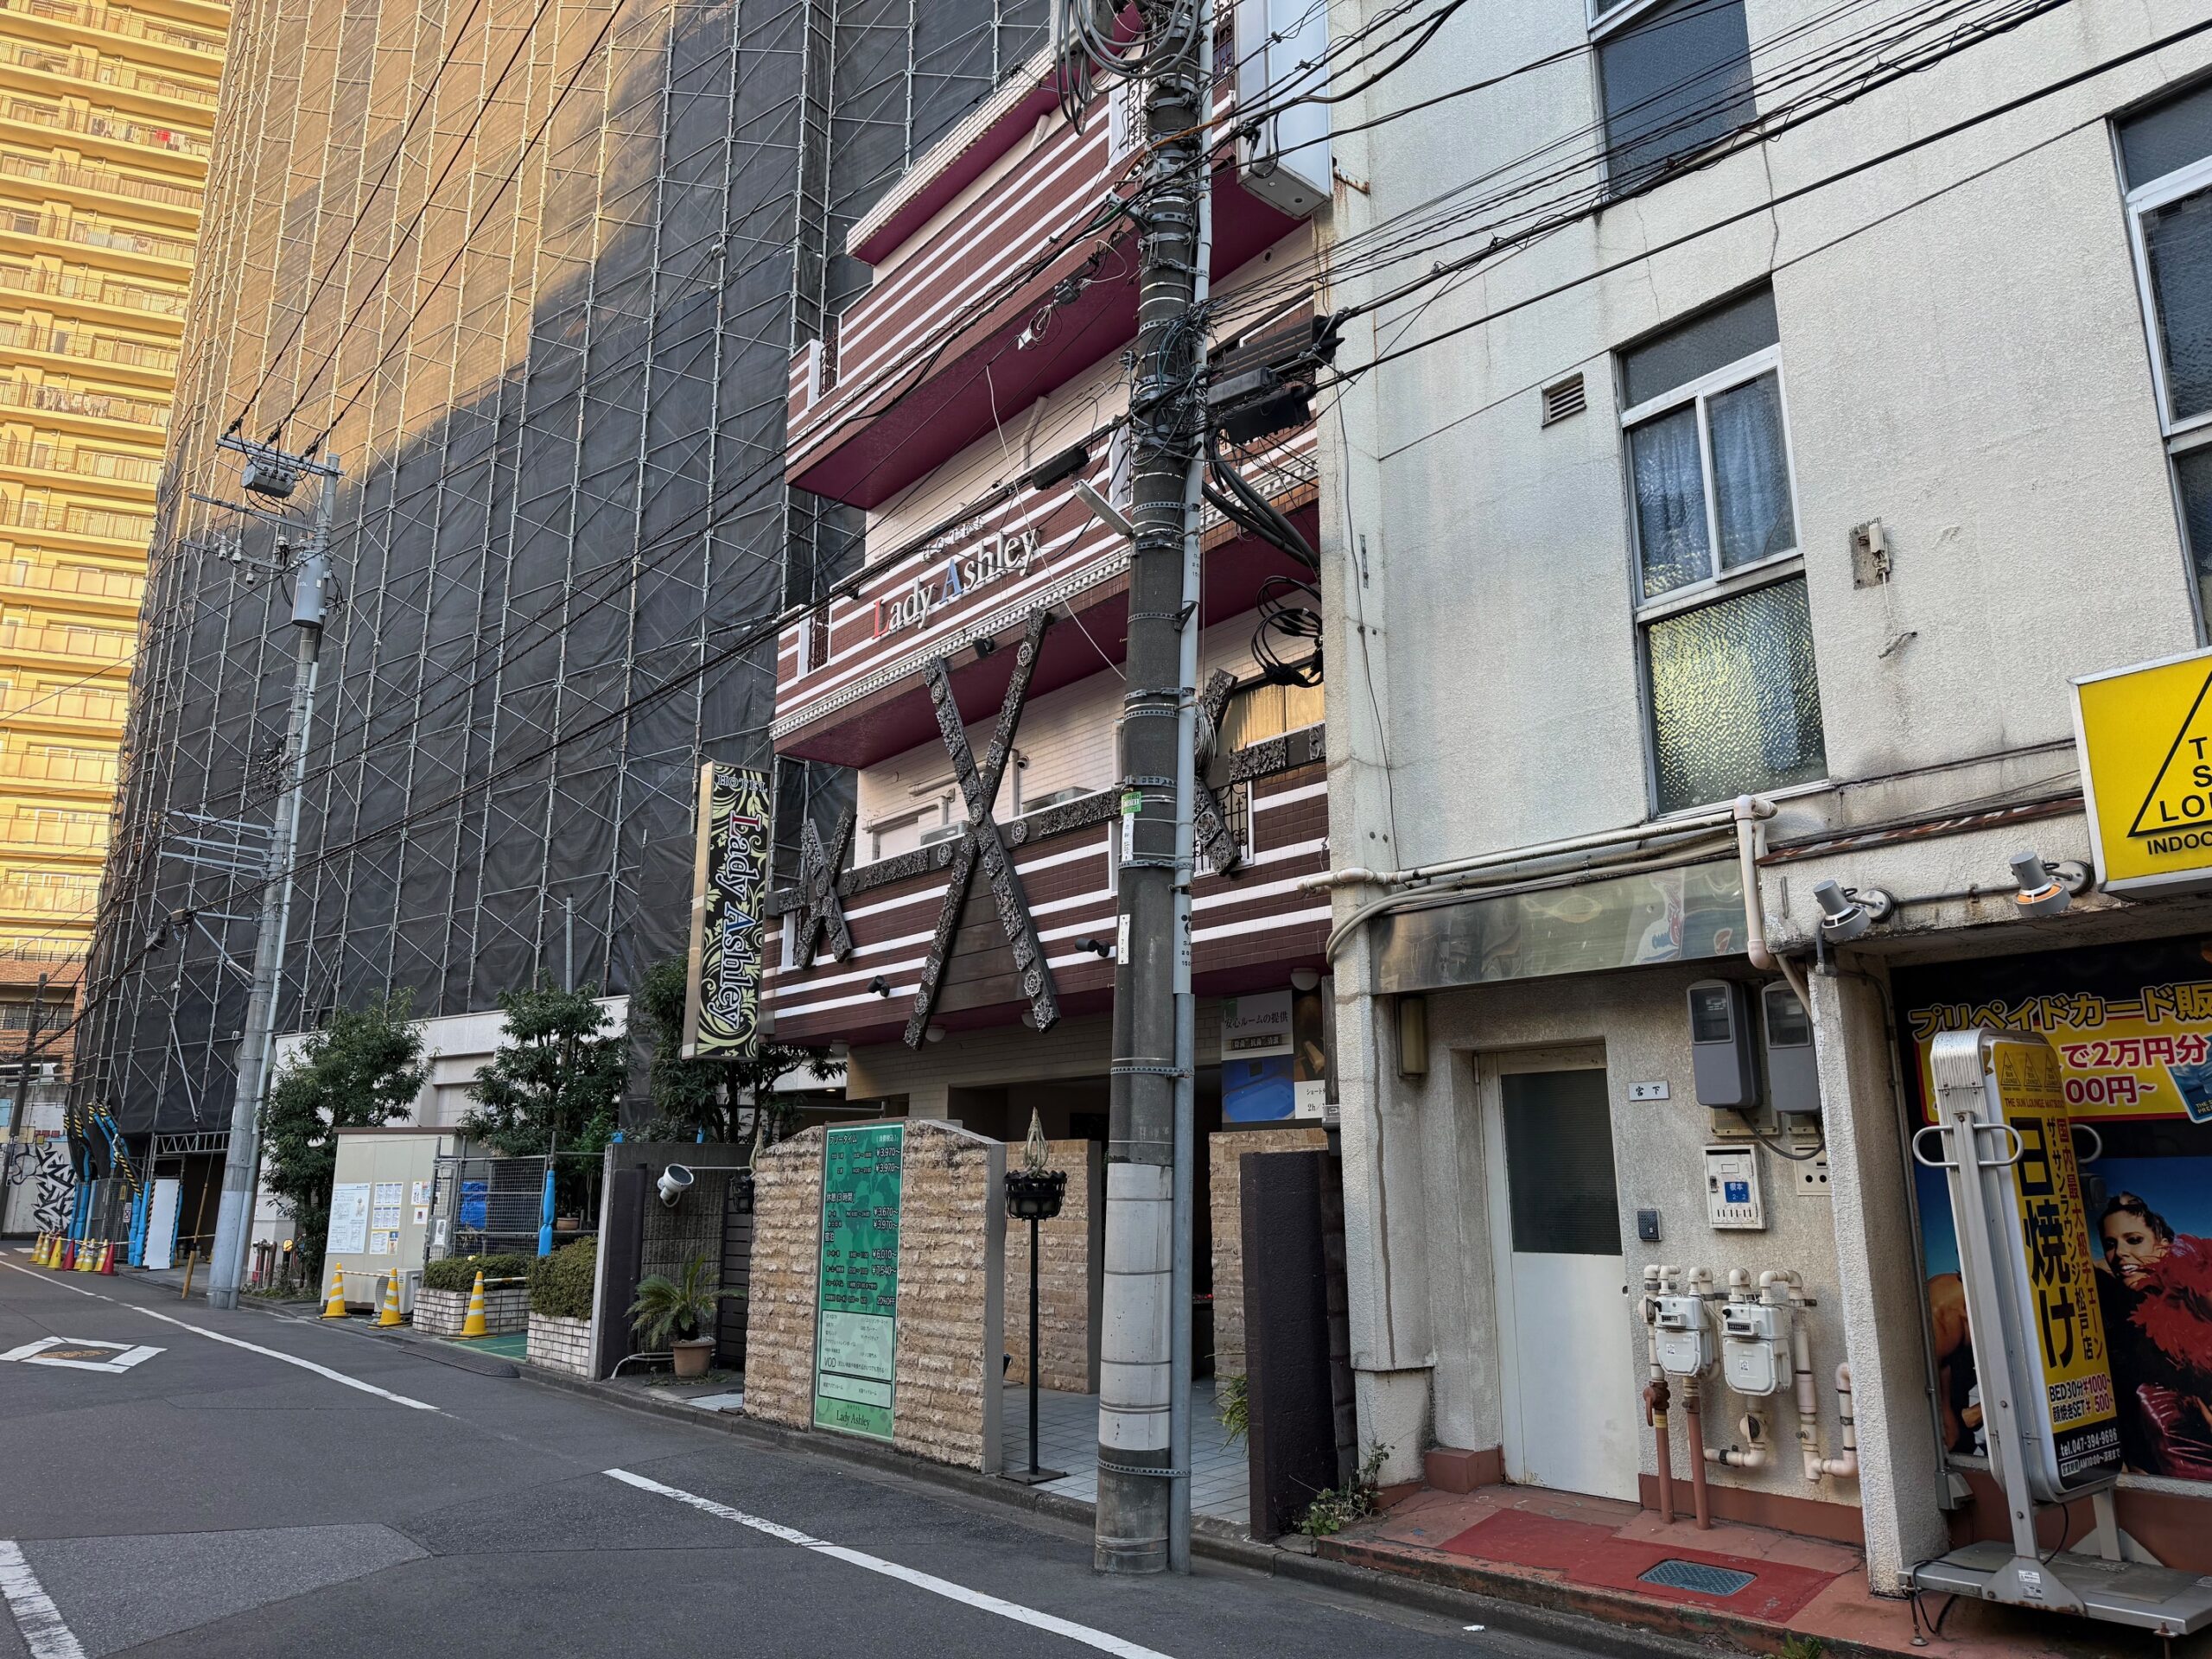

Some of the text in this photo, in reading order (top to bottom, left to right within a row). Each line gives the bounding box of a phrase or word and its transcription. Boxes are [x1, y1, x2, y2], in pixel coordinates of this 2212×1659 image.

[921, 515, 985, 562] HOTEL
[872, 528, 1039, 640] Lady Ashley
[717, 773, 768, 792] HOTEL
[2159, 792, 2212, 823] LO
[707, 810, 761, 1030] Lady Ashley
[1224, 1011, 1288, 1029] 安心ルームの提供
[830, 1134, 857, 1145] フリータイム
[2010, 1116, 2075, 1369] 日焼け
[836, 1410, 871, 1430] Lady Ashley
